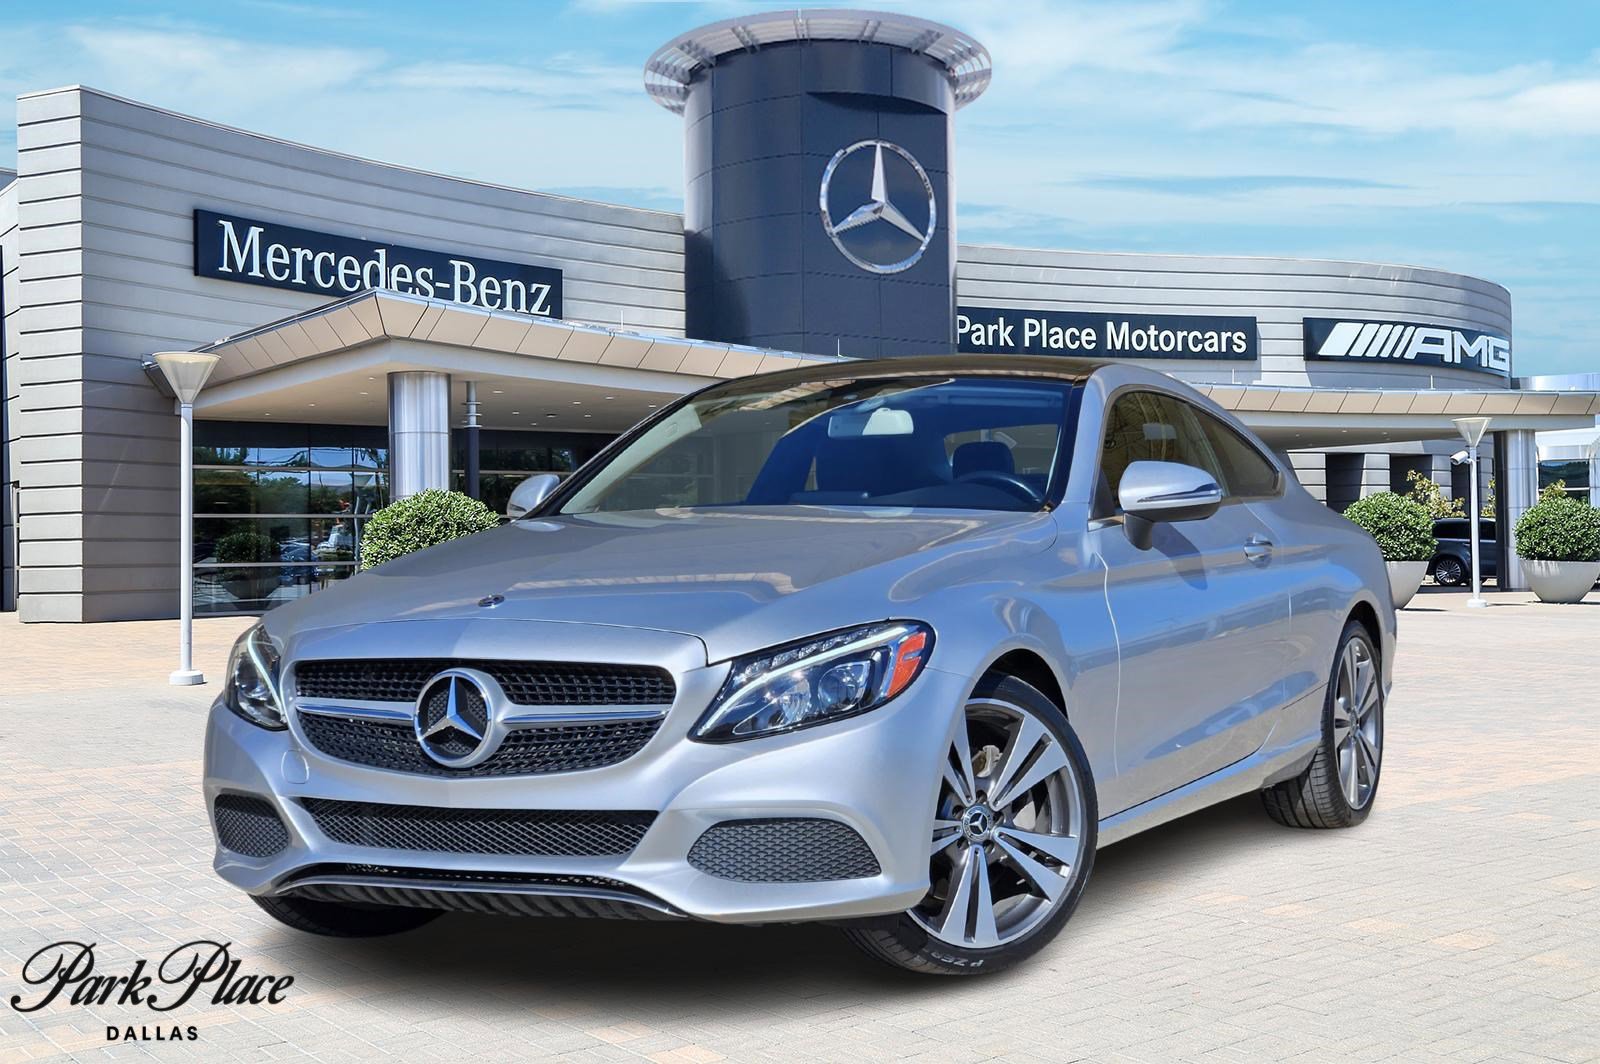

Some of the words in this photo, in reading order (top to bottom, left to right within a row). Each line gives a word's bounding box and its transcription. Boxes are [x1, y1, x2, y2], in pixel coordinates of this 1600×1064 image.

[218, 220, 552, 316] Mercedes-Benz
[957, 314, 1015, 347] Park
[1024, 318, 1097, 350] Place
[1106, 321, 1247, 353] Motorcars
